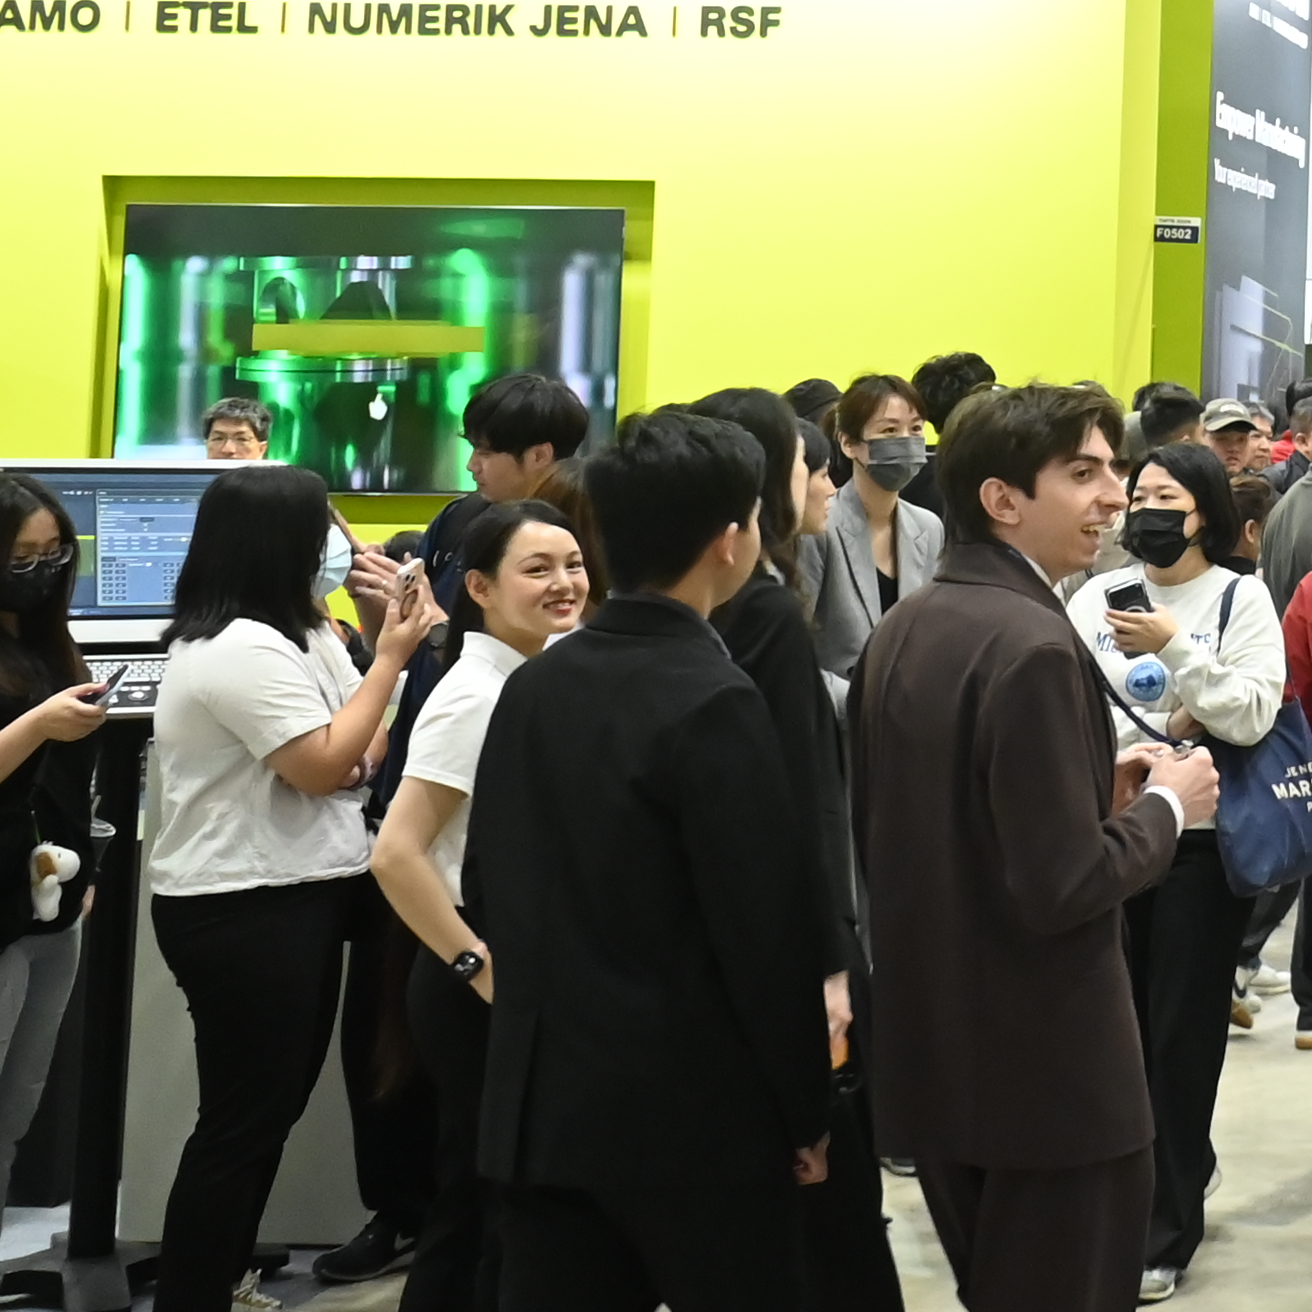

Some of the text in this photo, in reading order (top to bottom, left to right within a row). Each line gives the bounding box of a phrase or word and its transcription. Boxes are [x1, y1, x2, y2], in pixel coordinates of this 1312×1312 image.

[0, 0, 782, 38] AMO ETEL NUMERIK JENA RSF
[1156, 228, 1192, 240] F0502
